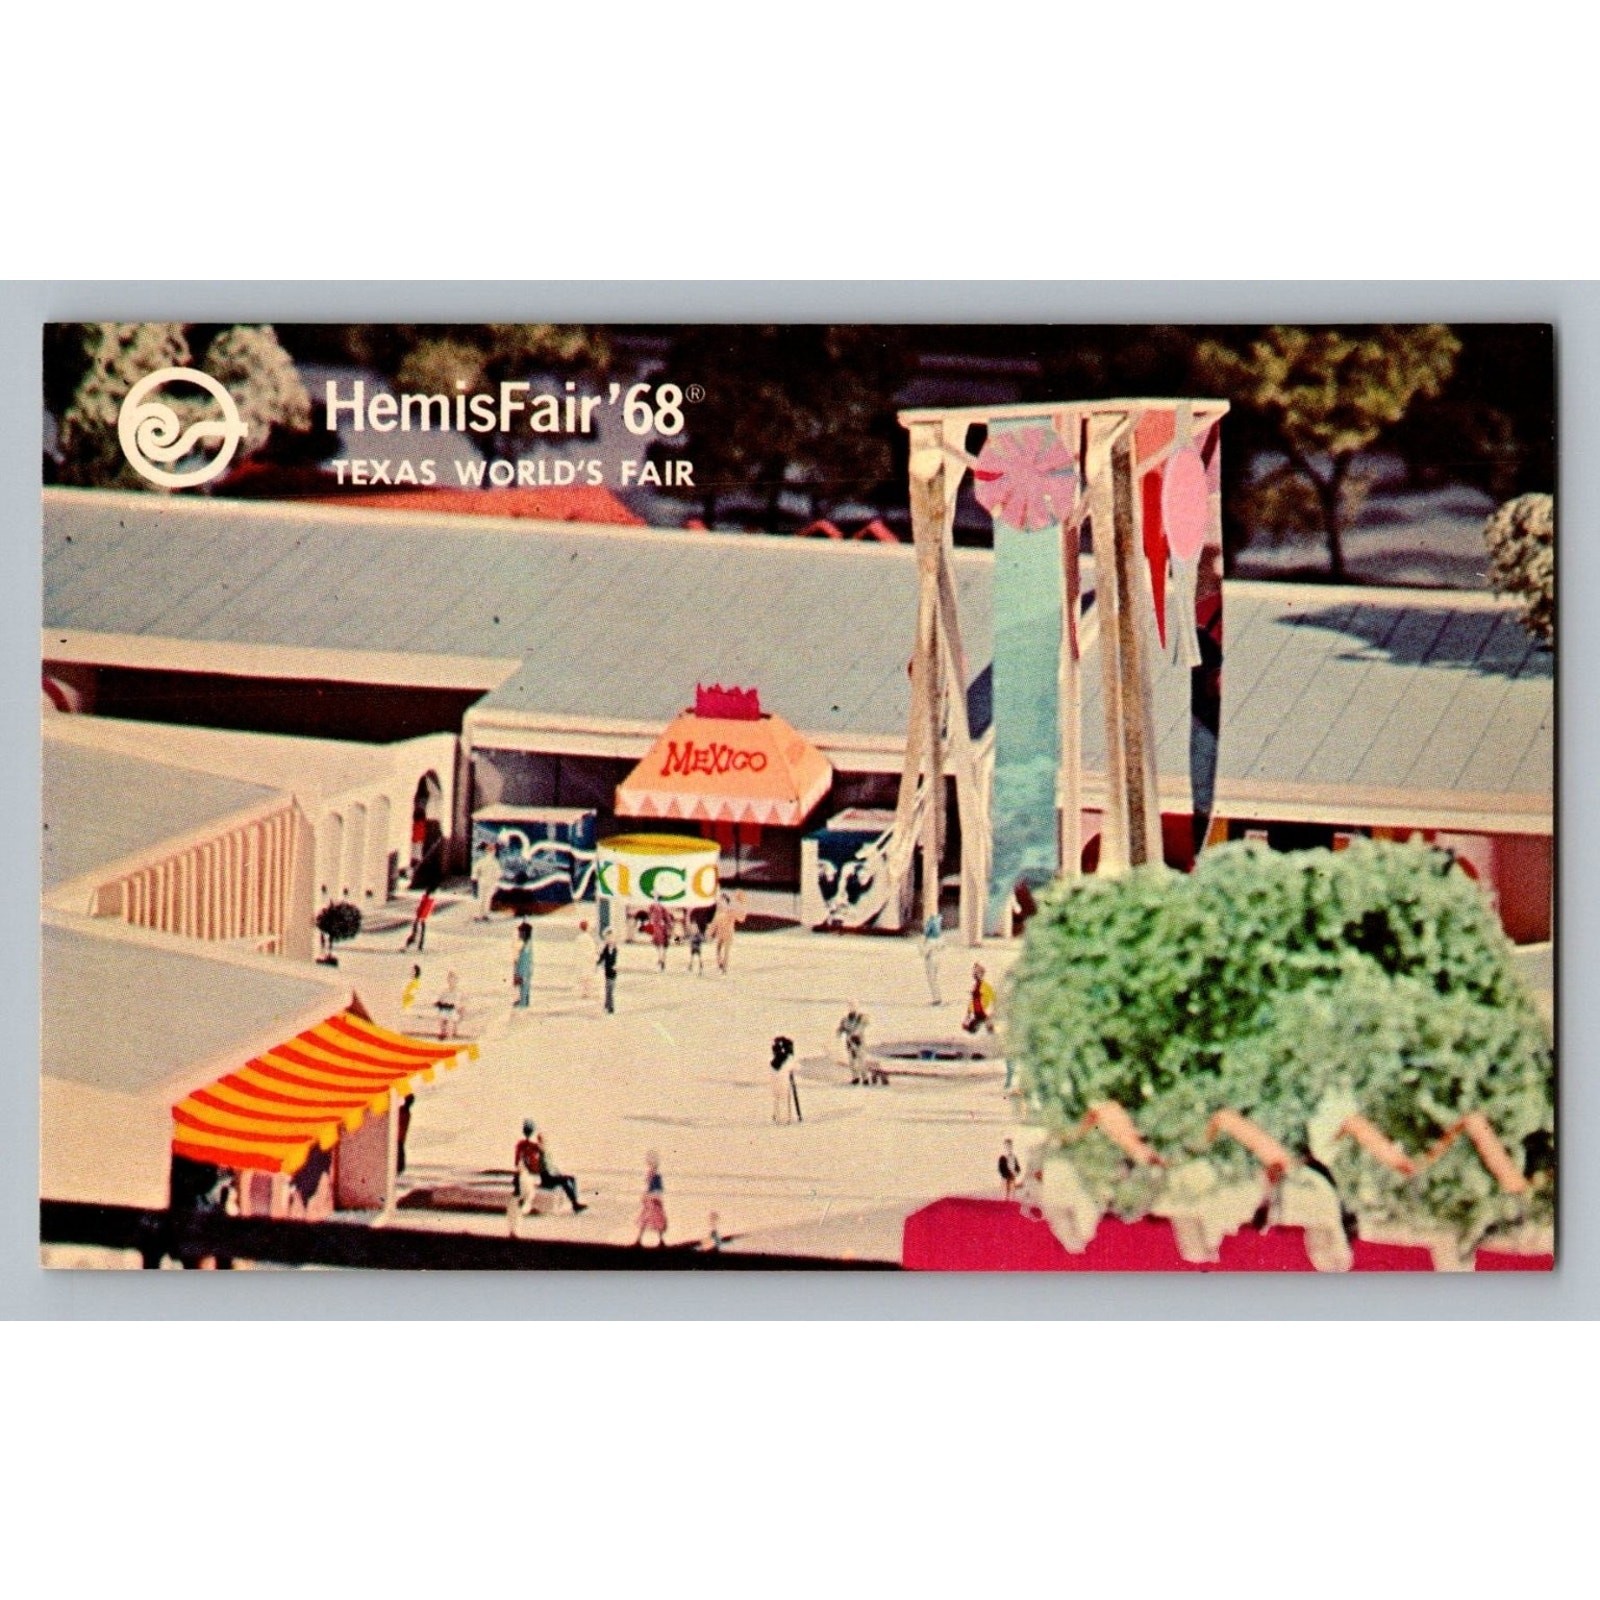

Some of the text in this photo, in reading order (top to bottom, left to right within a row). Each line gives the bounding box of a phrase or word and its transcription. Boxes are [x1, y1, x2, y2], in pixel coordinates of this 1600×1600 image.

[326, 379, 601, 433] HemisFair
[332, 458, 696, 487] TEXAS WORLD'S FAIR
[660, 741, 767, 777] MEXICO
